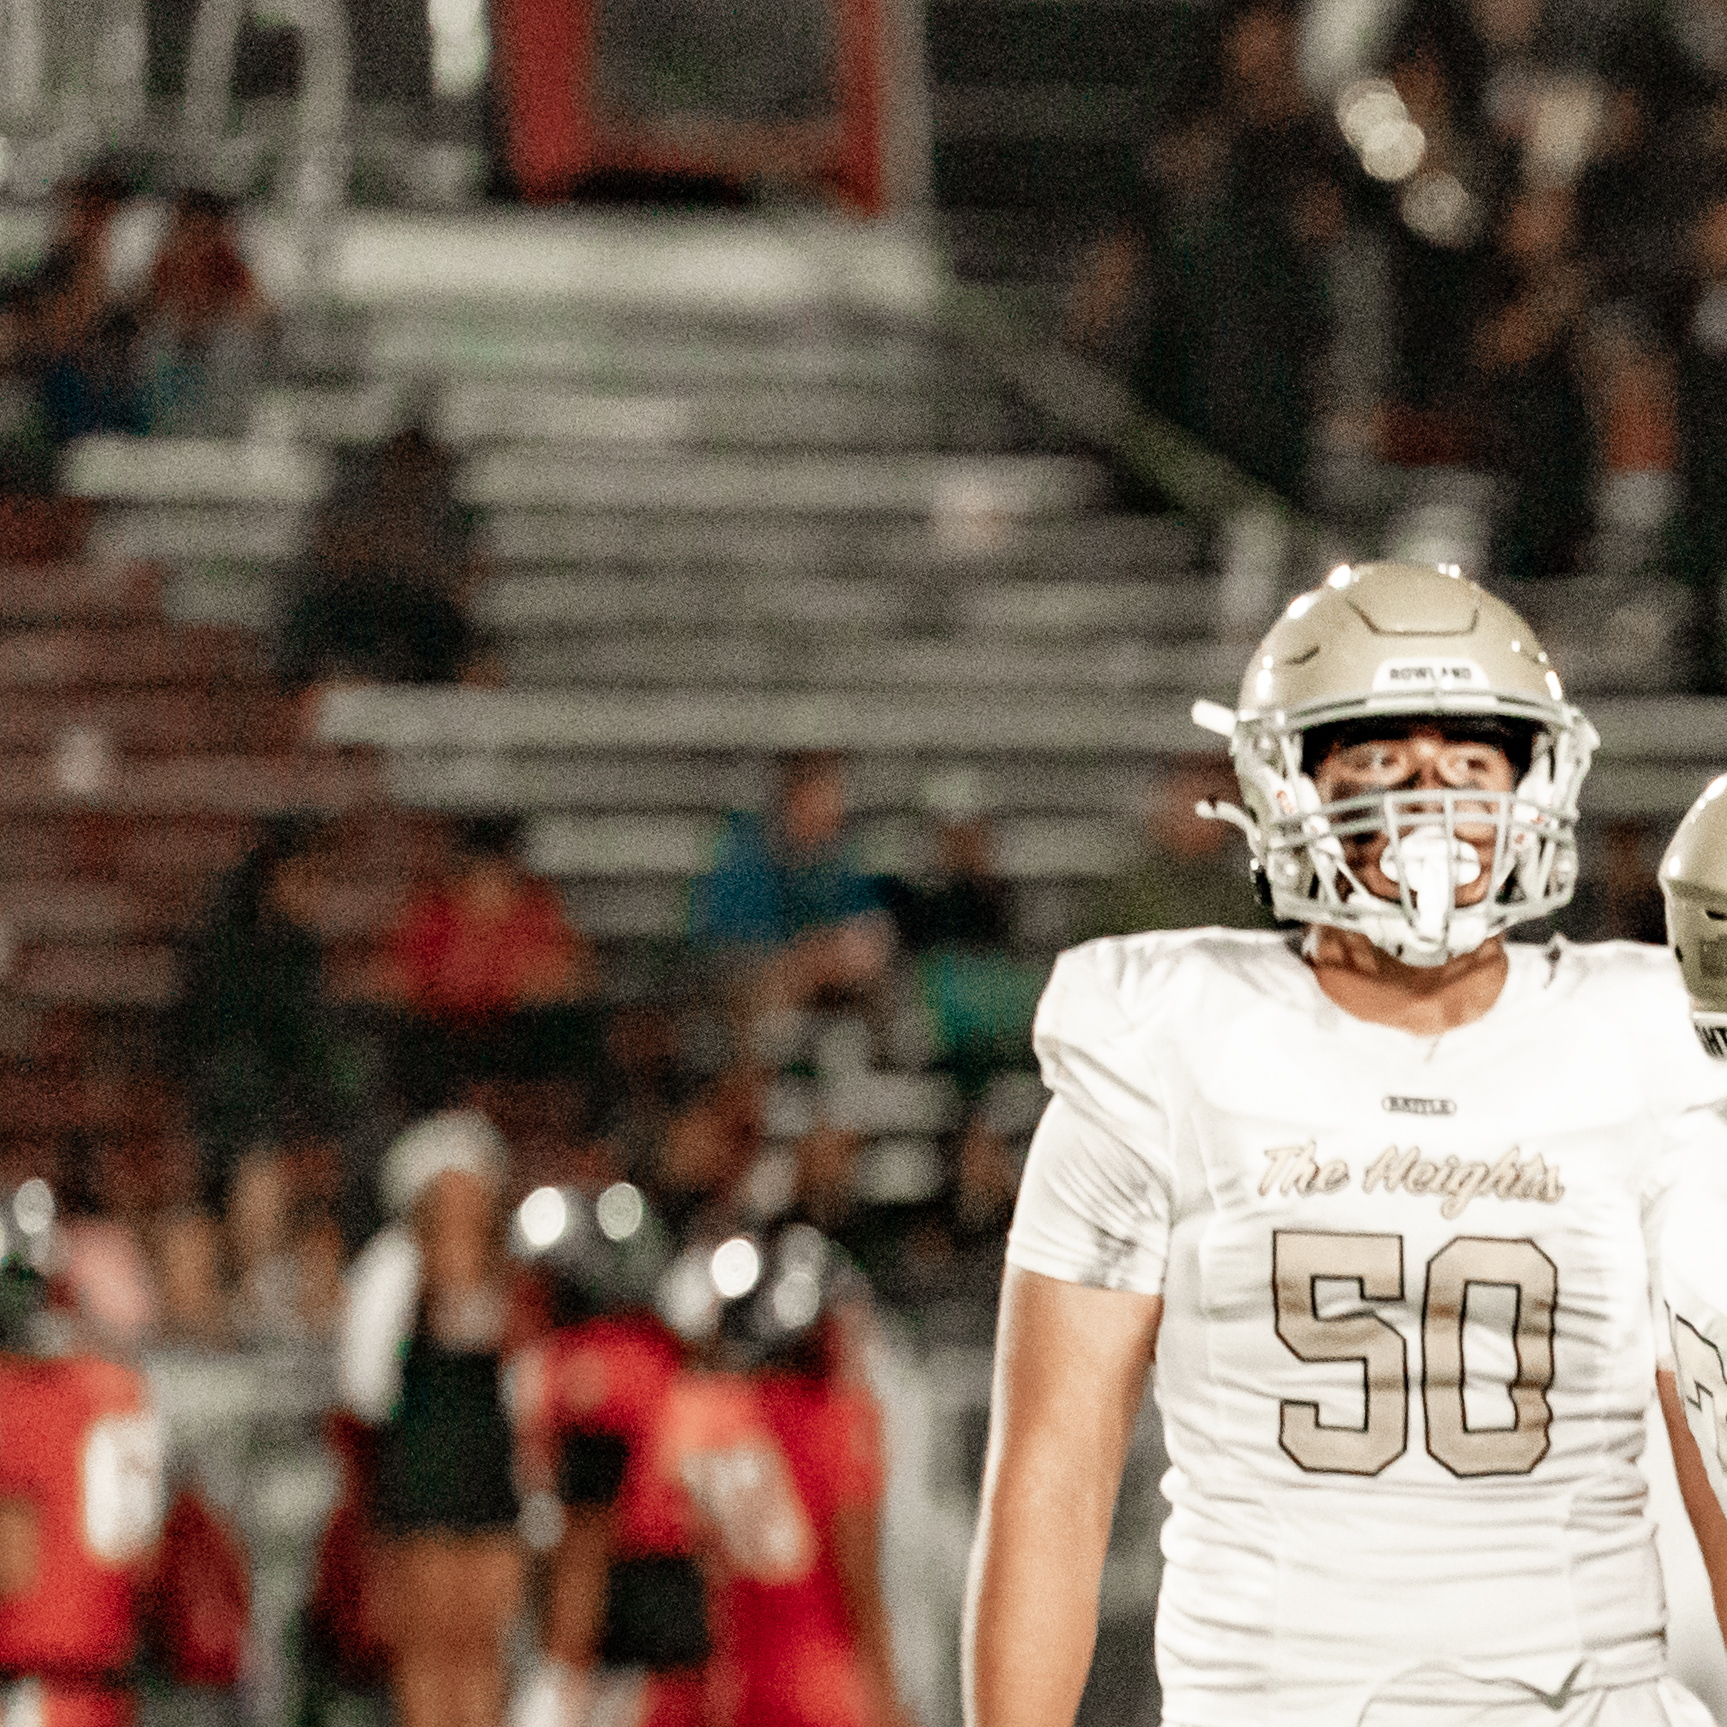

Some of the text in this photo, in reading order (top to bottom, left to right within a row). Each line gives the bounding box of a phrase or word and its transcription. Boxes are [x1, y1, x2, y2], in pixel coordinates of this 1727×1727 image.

[1257, 1138, 1567, 1222] The Heights
[1271, 1227, 1559, 1480] 50
